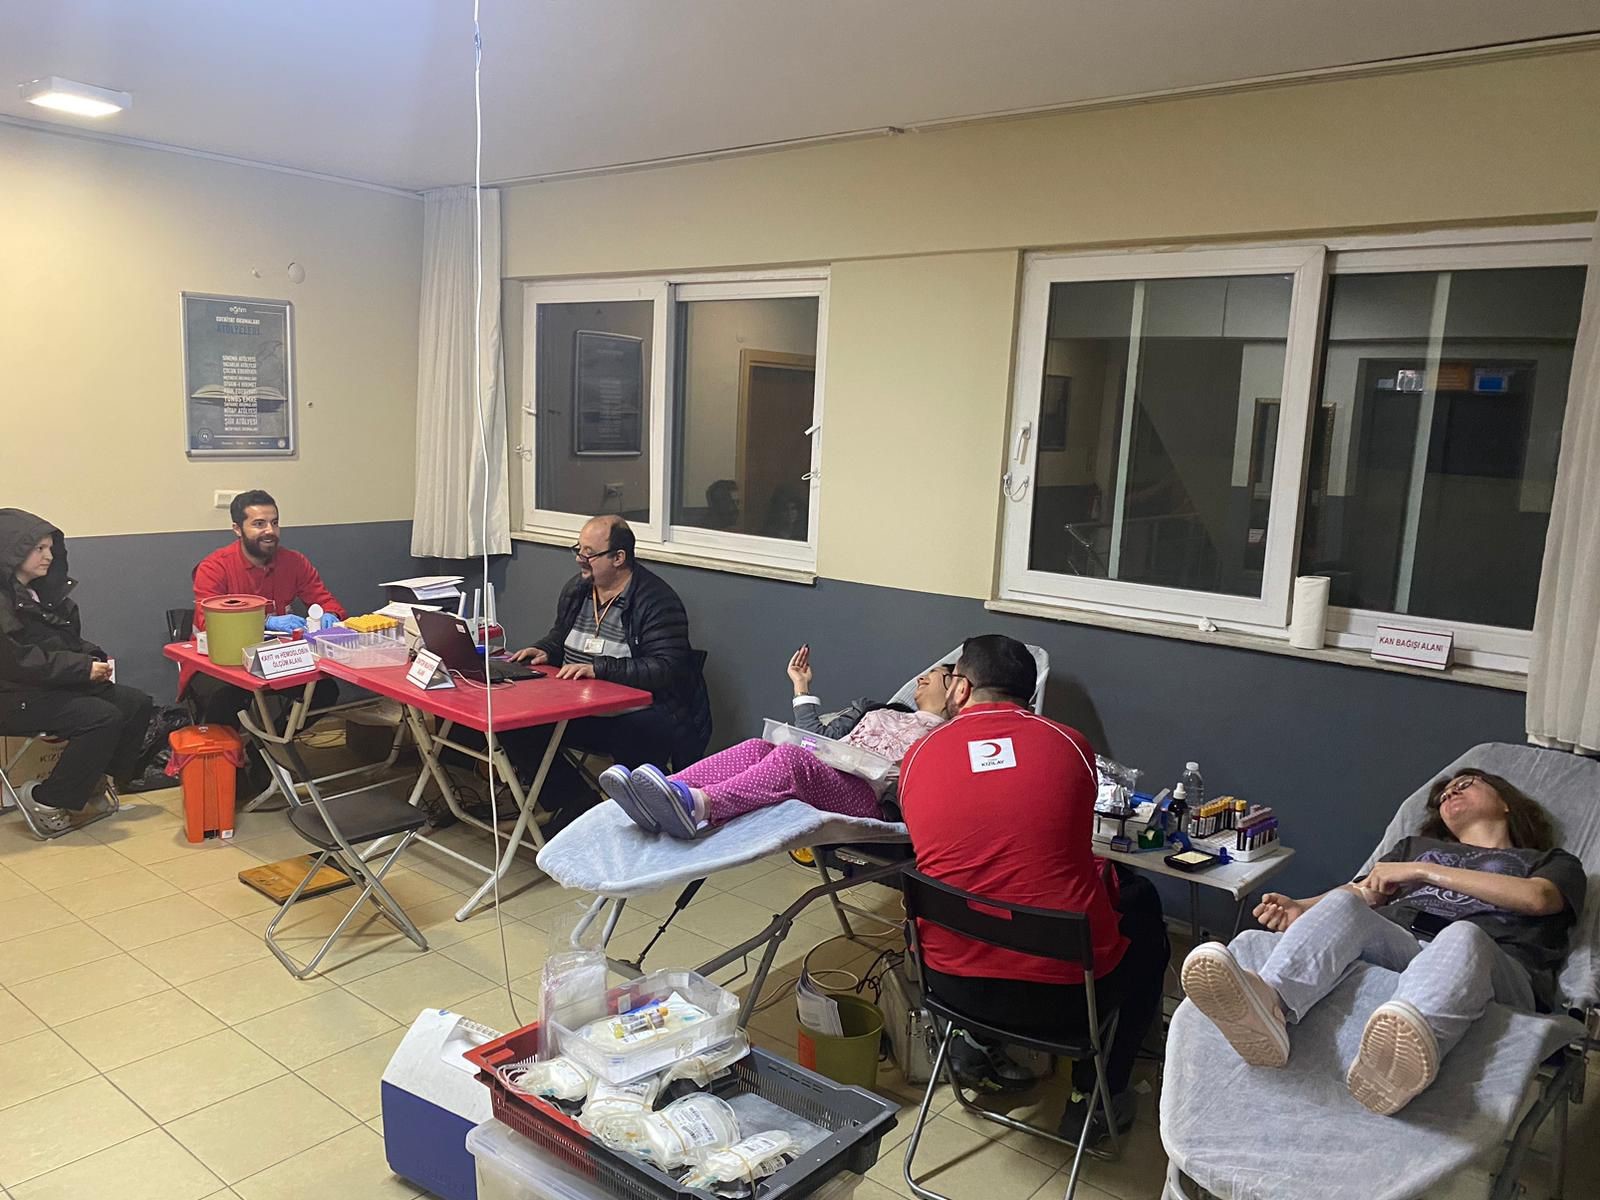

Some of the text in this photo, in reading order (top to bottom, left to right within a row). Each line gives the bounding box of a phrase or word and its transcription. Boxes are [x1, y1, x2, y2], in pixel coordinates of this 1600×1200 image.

[1379, 636, 1444, 652] KAN BAĞIŞI ALANI
[261, 654, 273, 662] KAYIT
[272, 656, 303, 668] ÖLÇÜM ALANI
